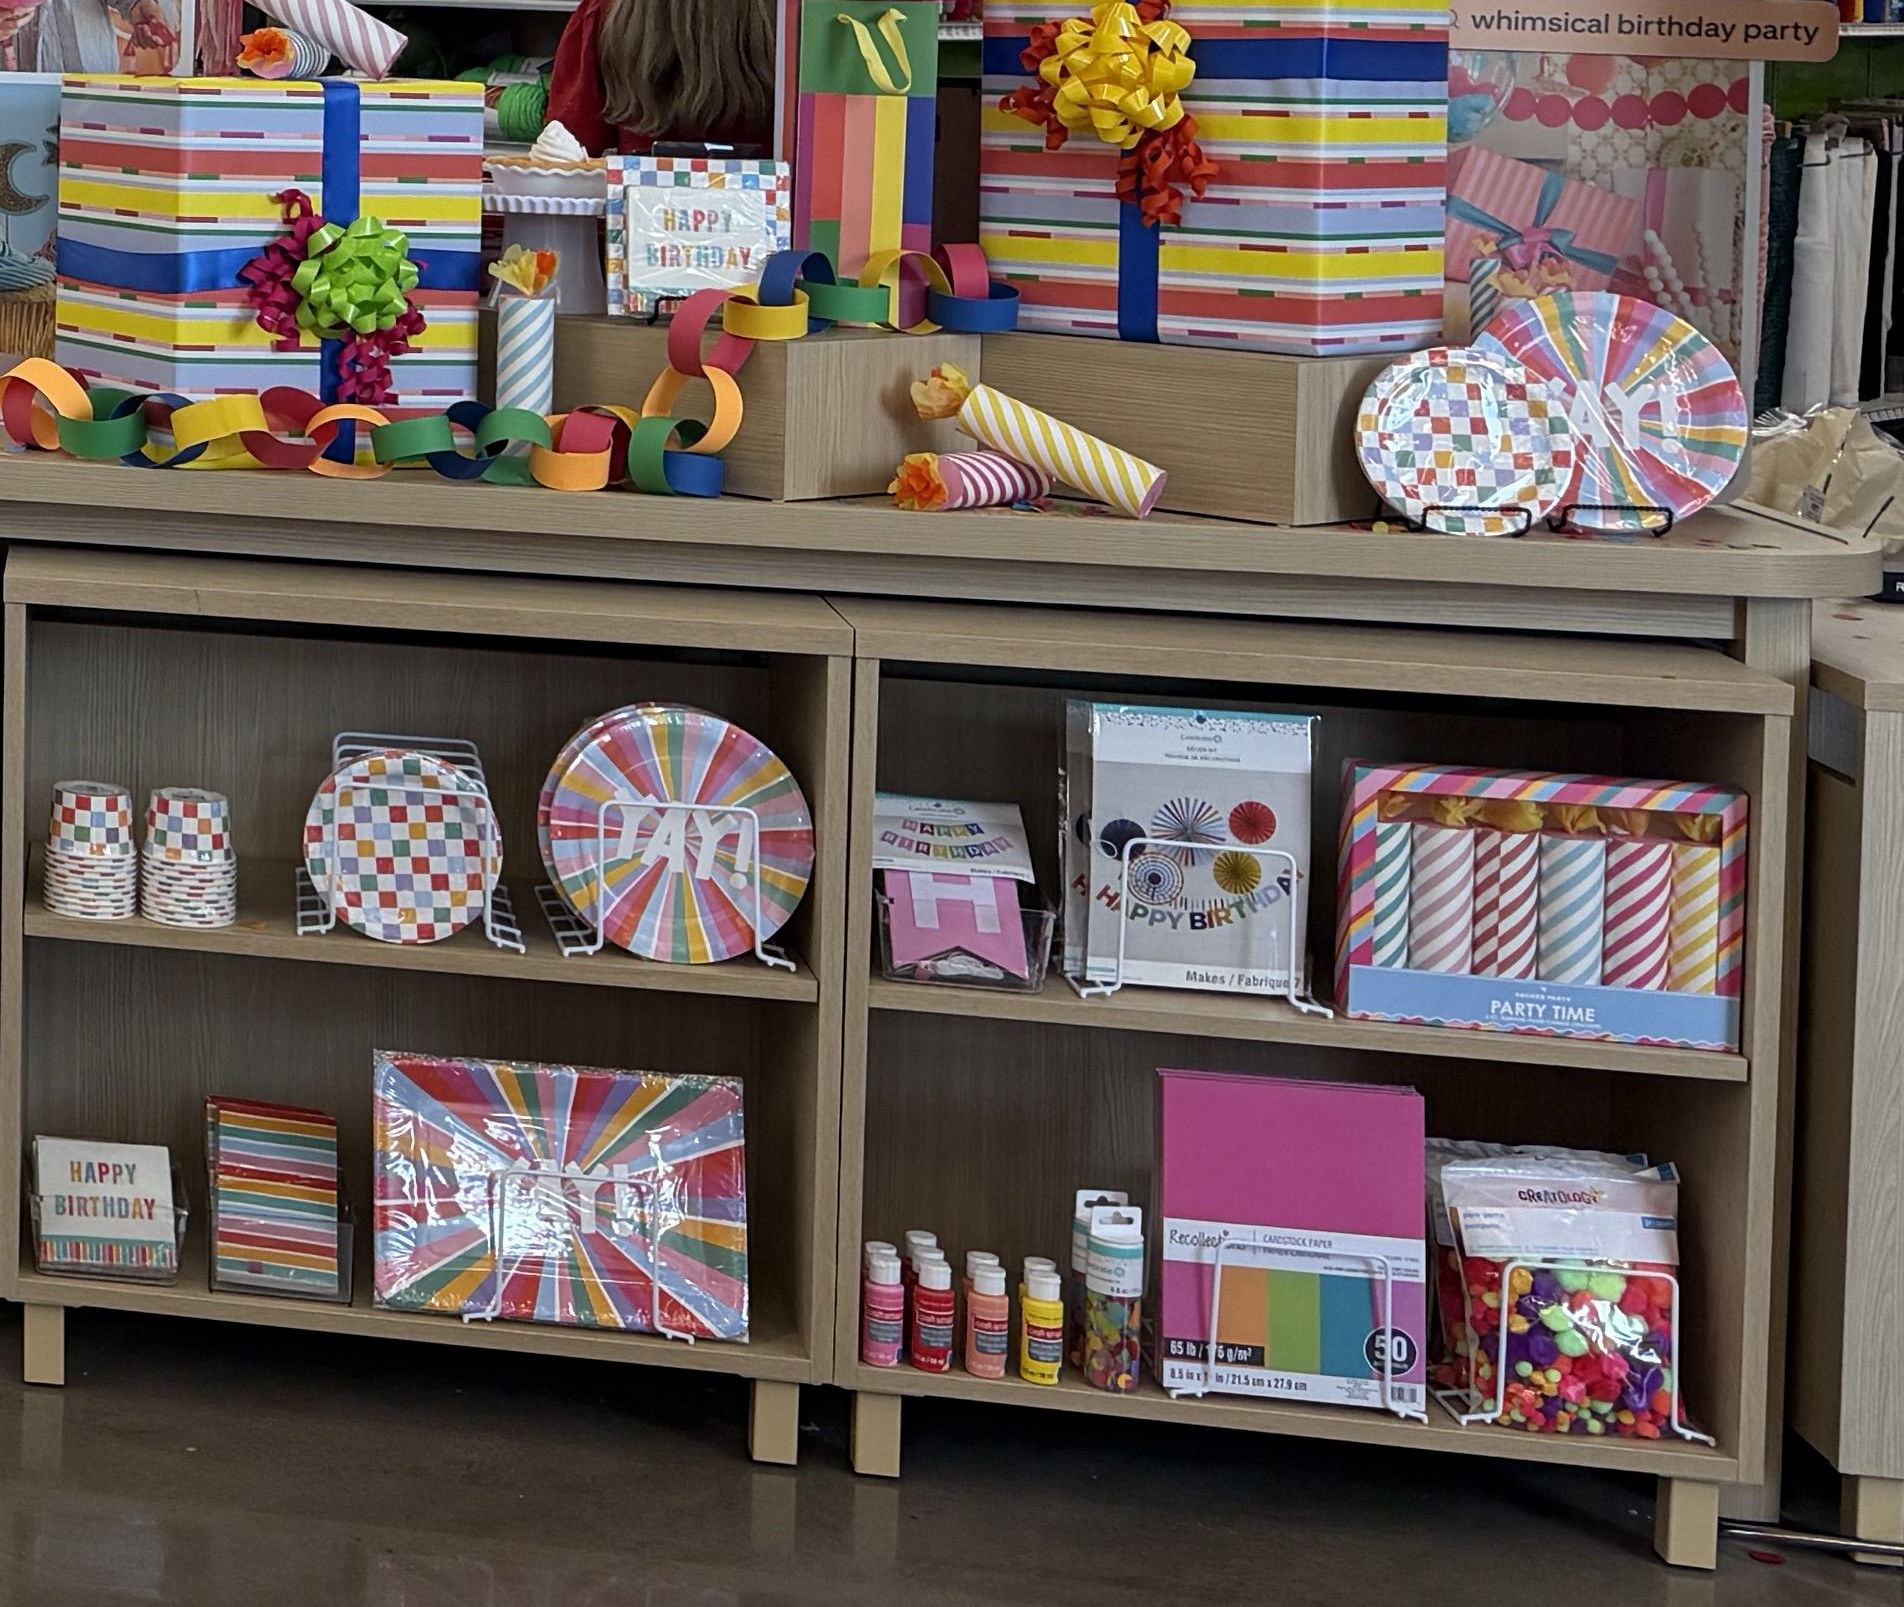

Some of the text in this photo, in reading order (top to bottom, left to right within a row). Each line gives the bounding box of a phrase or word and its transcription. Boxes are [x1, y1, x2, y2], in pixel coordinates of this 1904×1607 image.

[1471, 9, 1820, 46] whimsical birthday party
[662, 207, 733, 233] HAPPY
[645, 245, 752, 269] BIRTHDAY
[1548, 376, 1683, 455] AY!
[614, 787, 751, 890] YAY!
[902, 819, 982, 837] HAPPY
[882, 831, 1012, 858] BIRTHDAY
[1095, 884, 1185, 930] HAPPY
[1185, 970, 1290, 990] Makes Fabrique
[1490, 999, 1547, 1018] PARTY
[1551, 1003, 1596, 1023] TIME
[69, 1159, 138, 1186] HAPPY
[53, 1194, 157, 1222] BIRTHDAY
[1263, 1234, 1309, 1248] CARDSTOCK
[1373, 1334, 1408, 1363] 50
[1231, 1373, 1293, 1390] 21.5 27.9
